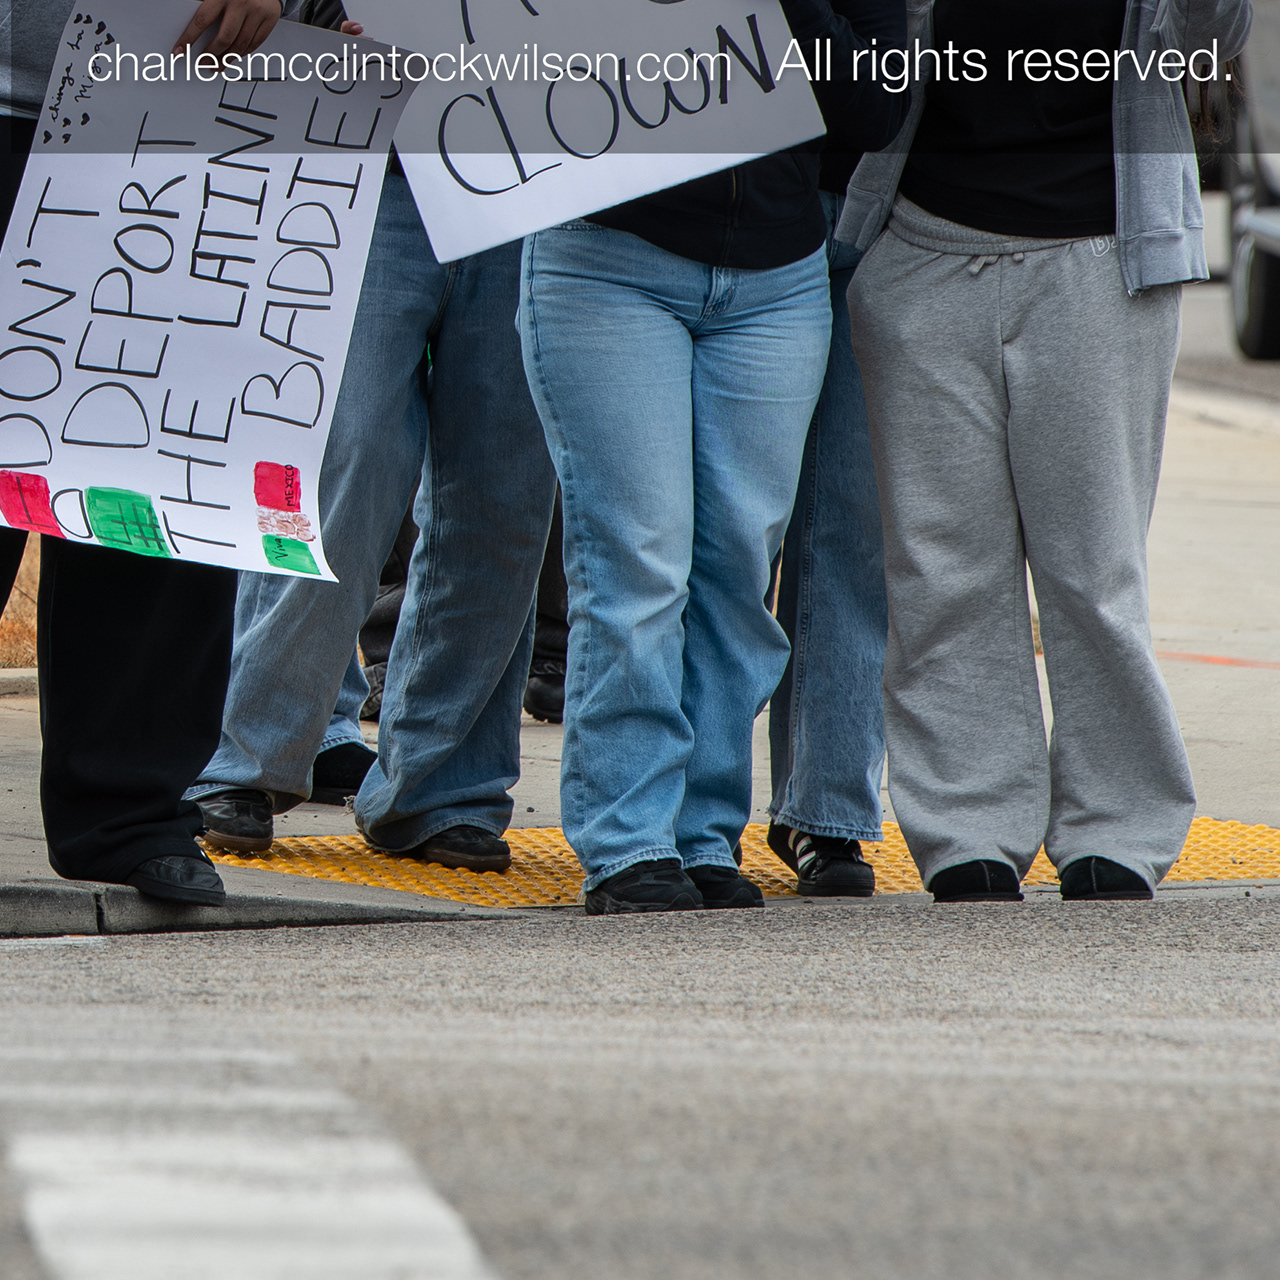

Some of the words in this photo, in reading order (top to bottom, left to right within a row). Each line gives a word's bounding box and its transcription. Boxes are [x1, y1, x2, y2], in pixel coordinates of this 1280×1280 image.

[176, 76, 289, 329] LATINA
[437, 12, 776, 196] CLOWN
[60, 110, 197, 449] DEPORT
[240, 54, 406, 430] BADDIES
[157, 387, 237, 554] THE
[284, 463, 296, 507] MEXICO
